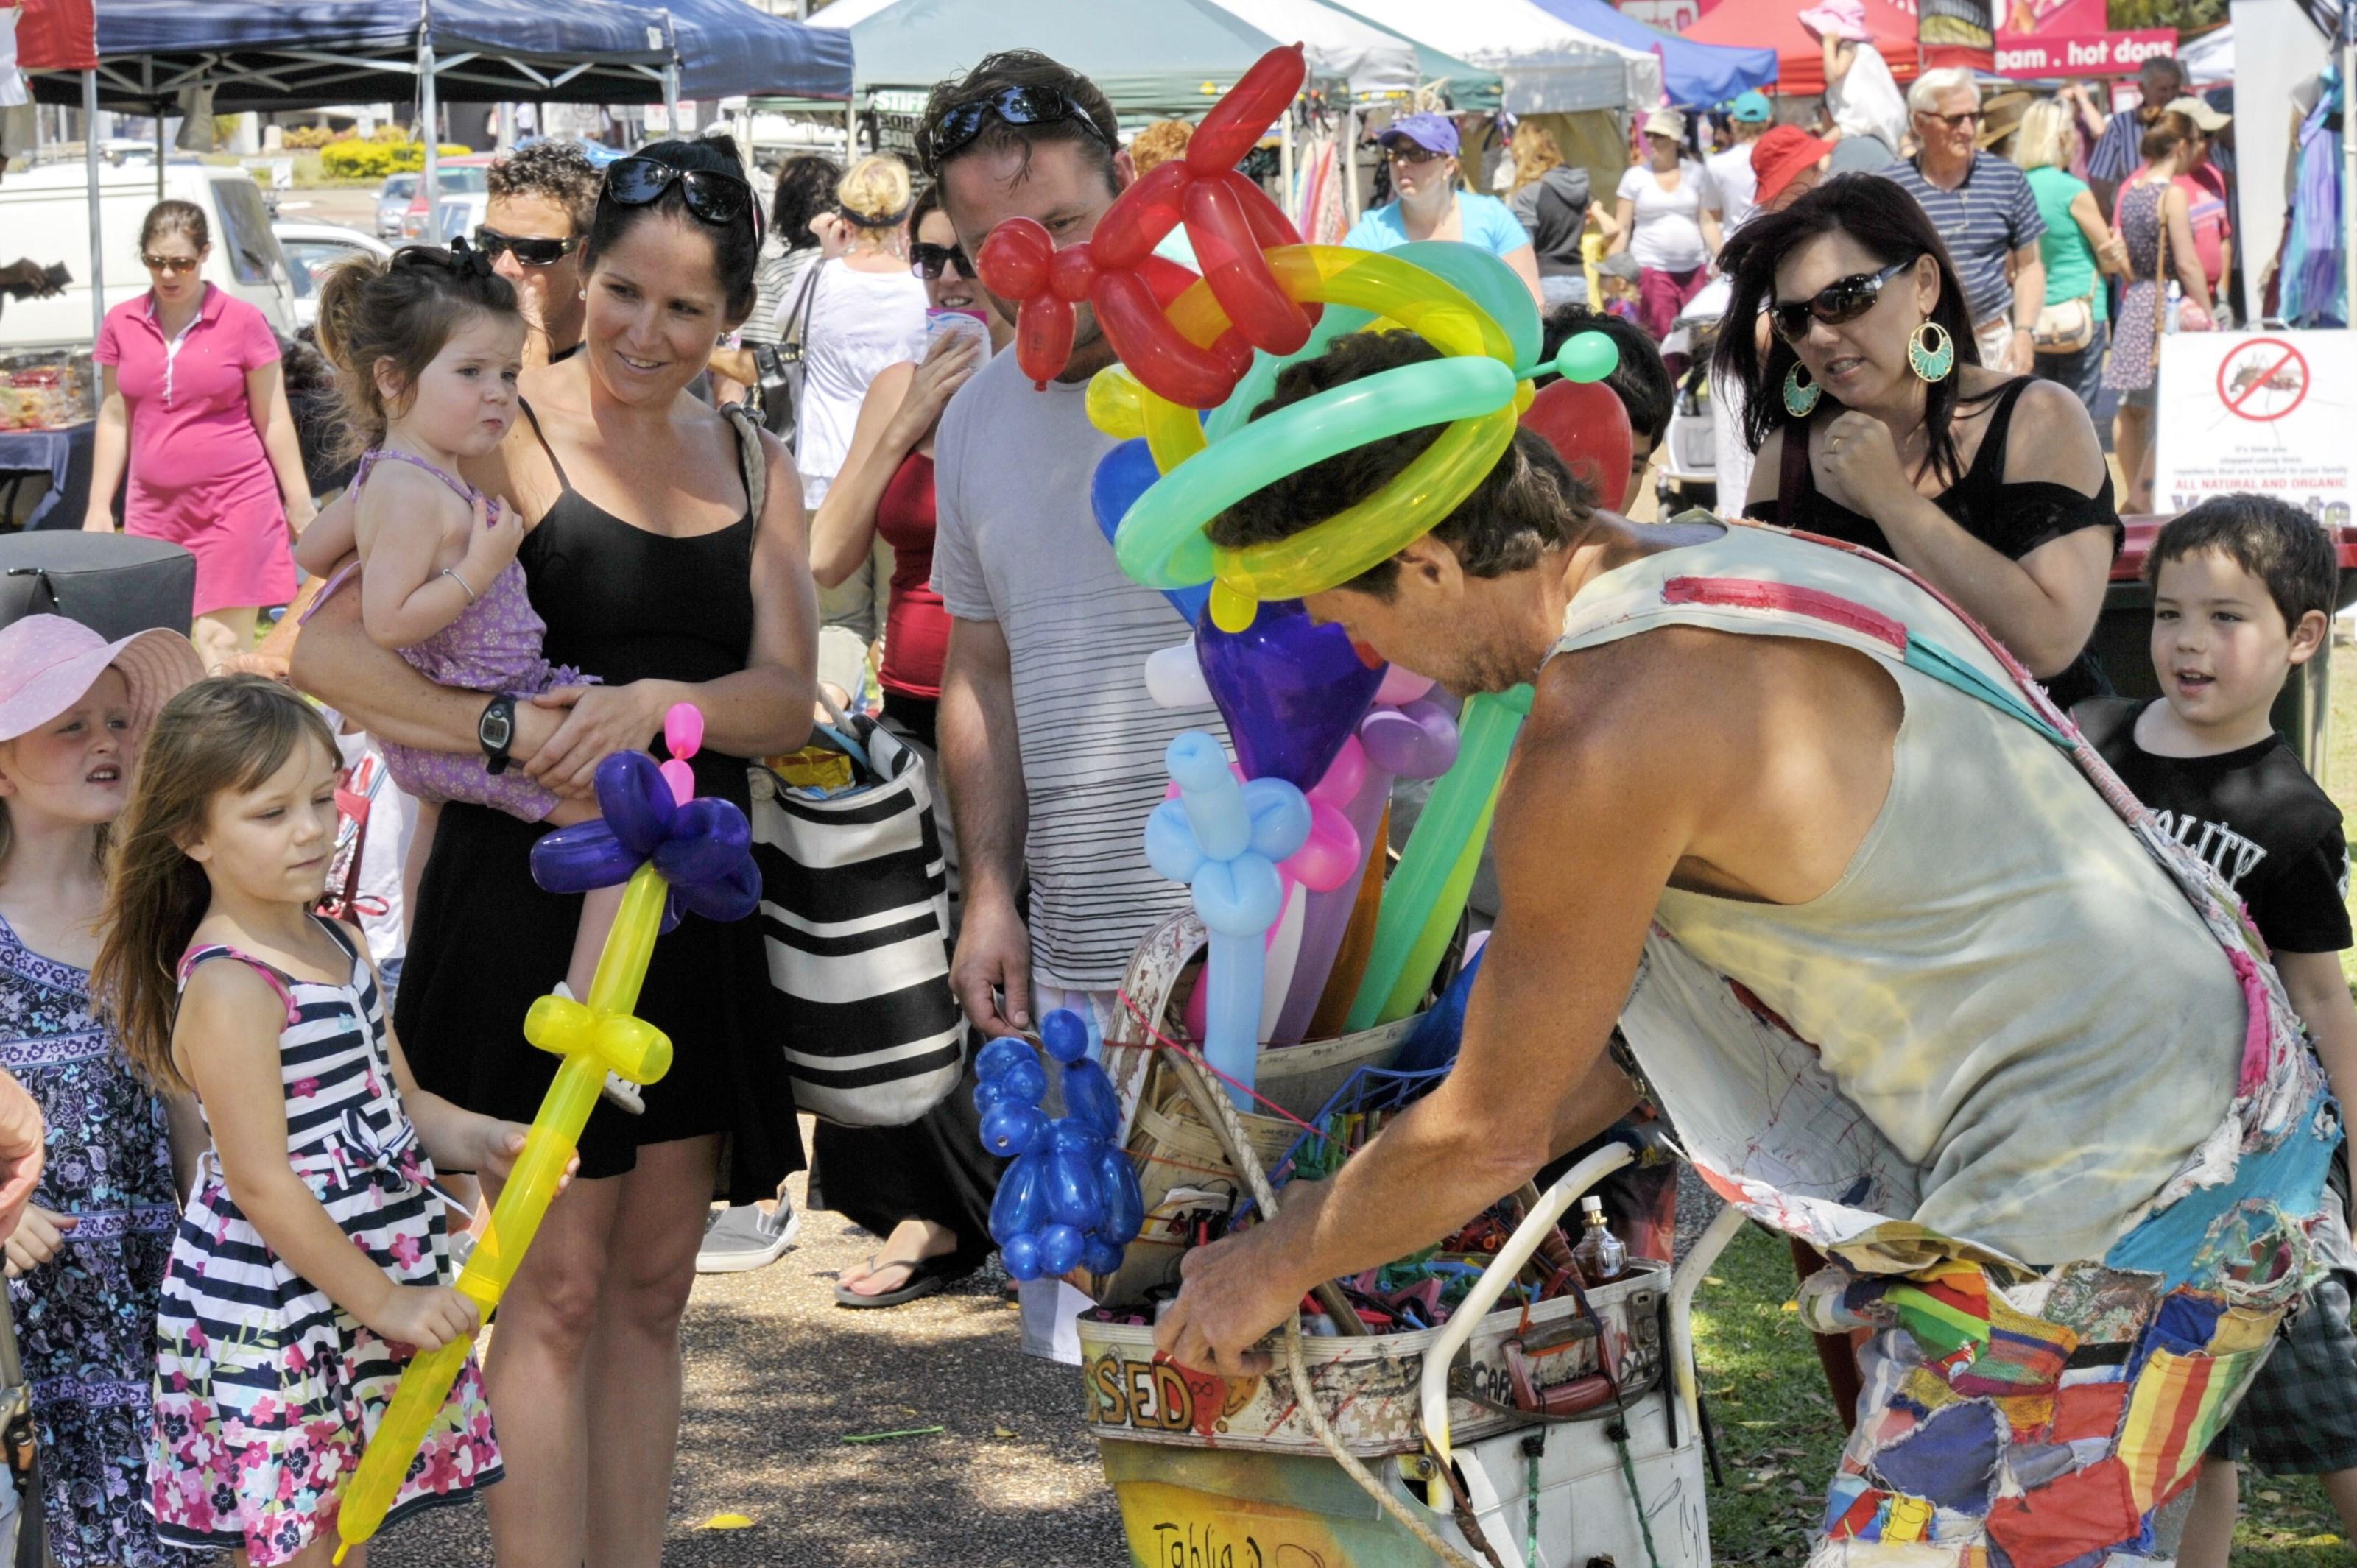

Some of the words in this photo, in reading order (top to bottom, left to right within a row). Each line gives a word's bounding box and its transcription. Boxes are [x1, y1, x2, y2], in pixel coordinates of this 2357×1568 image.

[2067, 40, 2110, 66] hot
[2175, 479, 2197, 490] ALL
[2201, 478, 2257, 490] NATURAL
[2261, 478, 2286, 489] AND
[2291, 478, 2347, 489] ORGANIC
